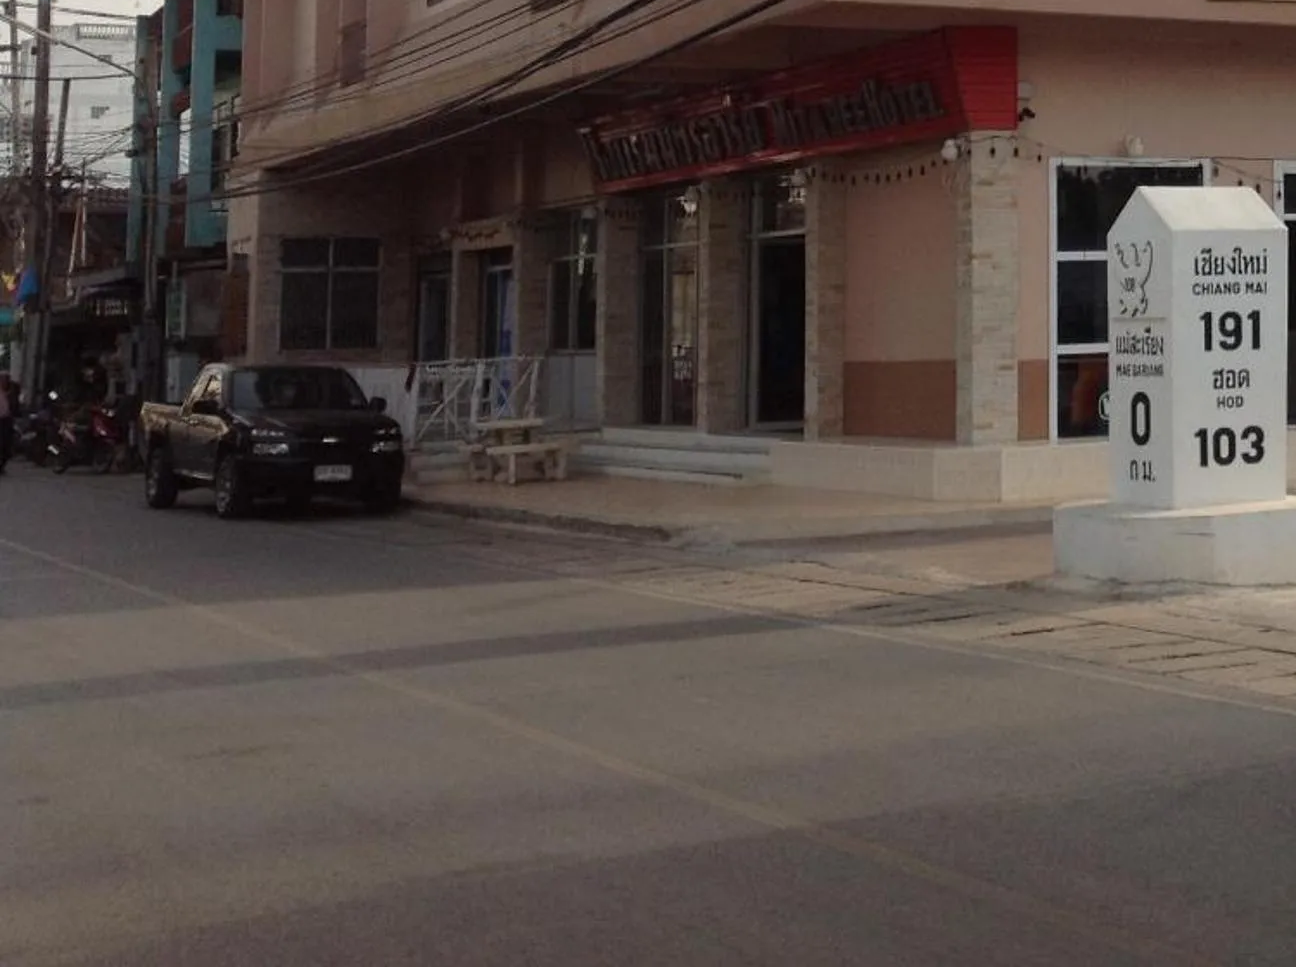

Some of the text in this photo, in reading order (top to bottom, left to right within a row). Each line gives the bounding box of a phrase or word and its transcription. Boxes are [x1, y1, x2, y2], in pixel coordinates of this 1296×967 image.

[1193, 247, 1268, 277] เชียงใหม่
[1192, 280, 1268, 296] CHIANG MAI
[1199, 309, 1262, 352] 191
[1212, 367, 1251, 391] ฮอด
[1216, 395, 1245, 410] HOD
[1131, 391, 1152, 447] 0
[1193, 424, 1266, 468] 103
